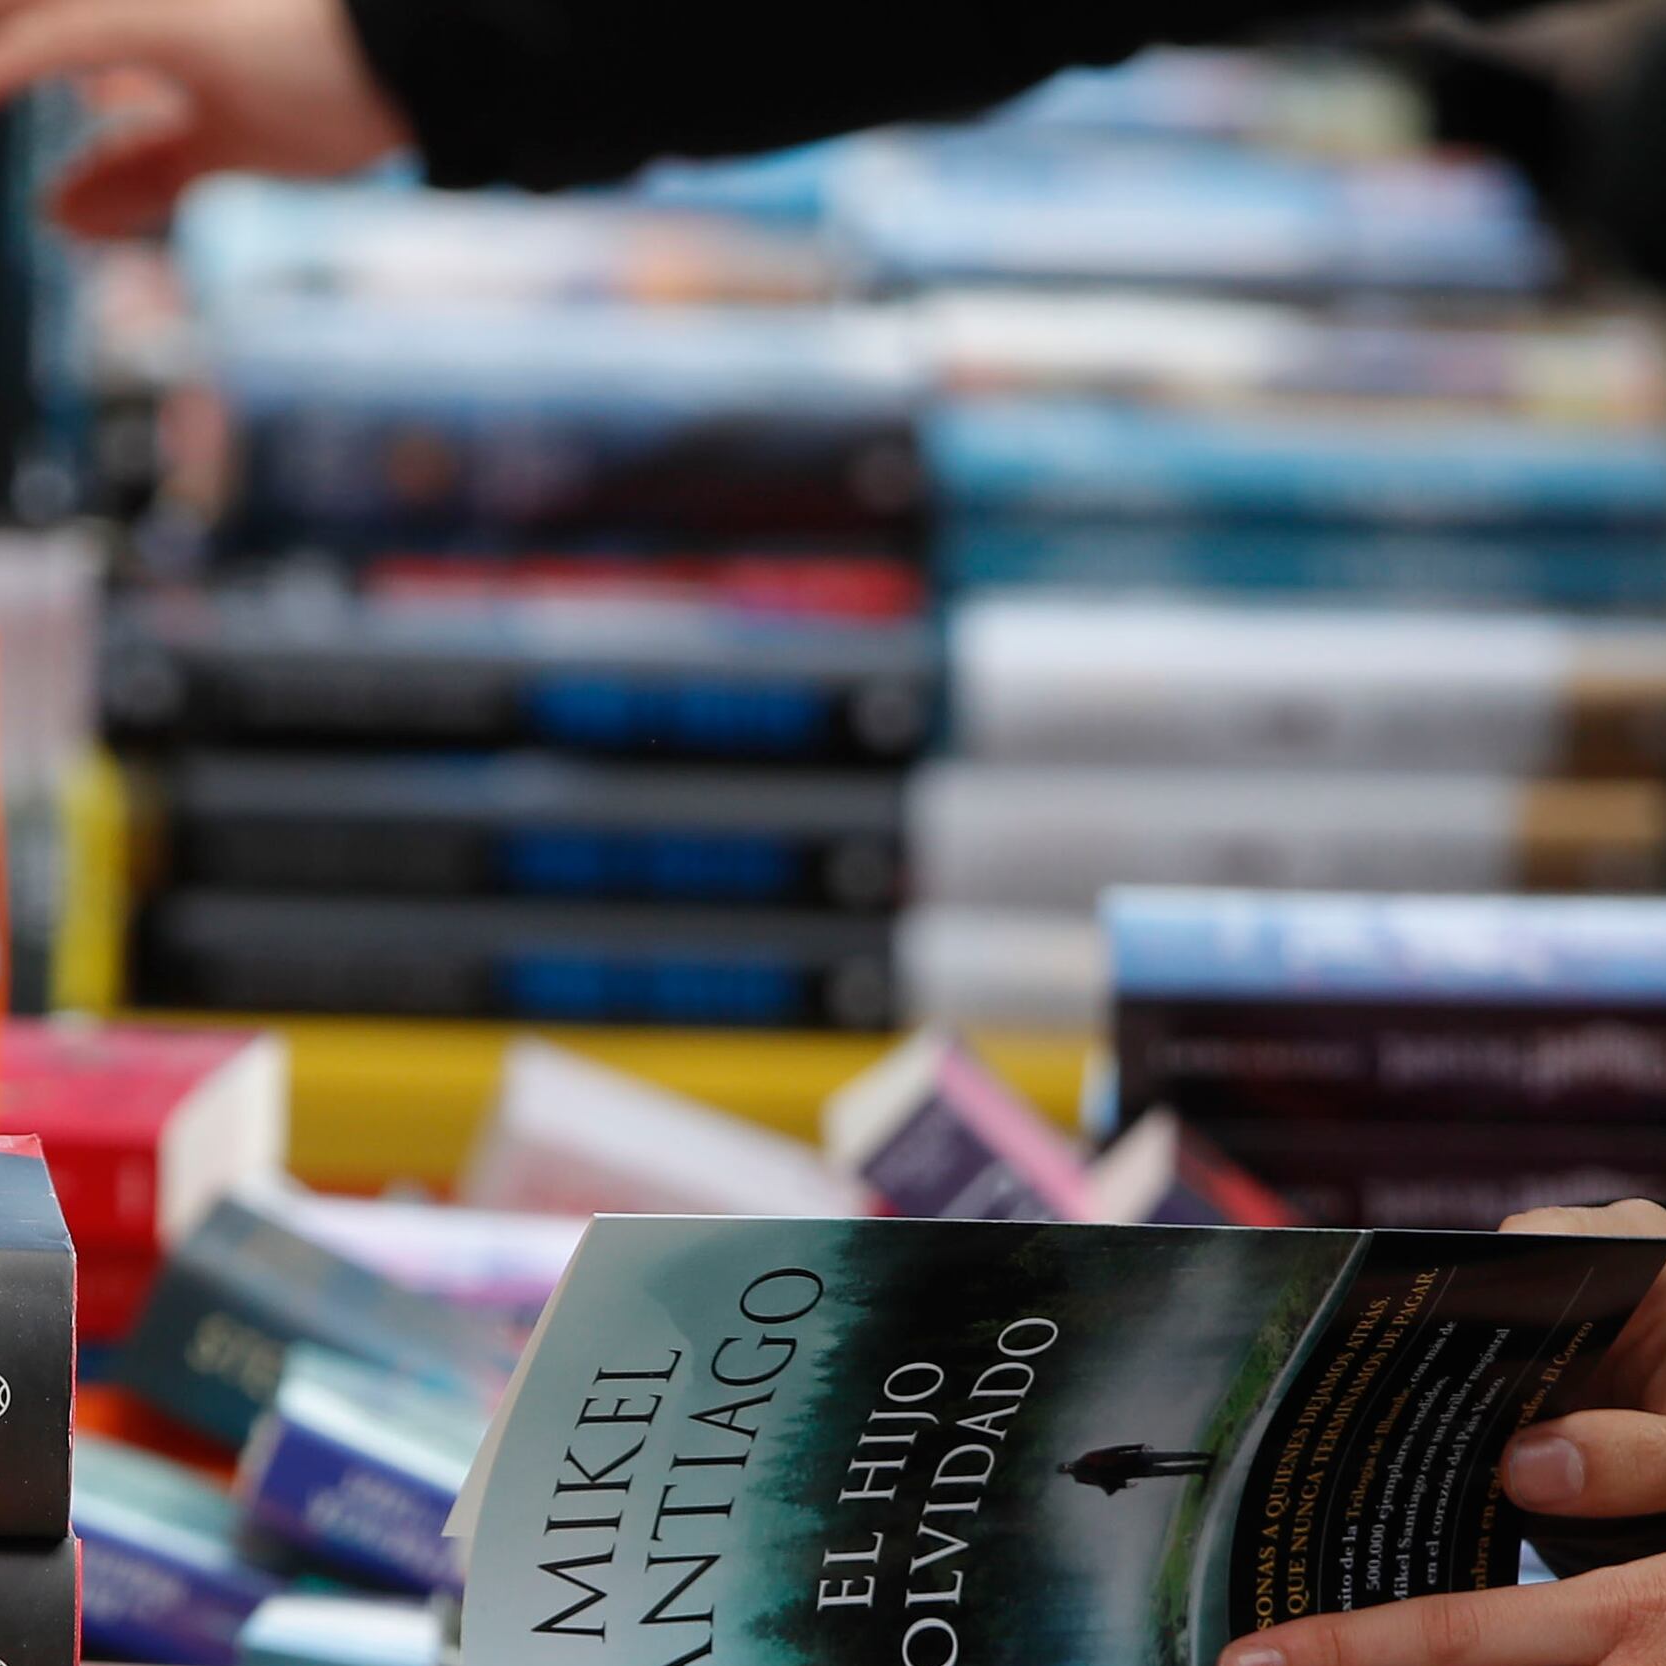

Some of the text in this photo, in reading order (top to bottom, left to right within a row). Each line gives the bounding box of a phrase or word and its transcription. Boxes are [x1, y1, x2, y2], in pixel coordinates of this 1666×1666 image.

[1376, 1327, 1404, 1349] DE
[1298, 1352, 1354, 1425] DEJAMOS
[1312, 1352, 1387, 1466] TERMINAMOS
[531, 1349, 682, 1643] MIKEL
[817, 1361, 945, 1611] EL HIJO
[1265, 1427, 1310, 1518] QUIENES
[1397, 1474, 1428, 1550] Santiago
[1420, 1445, 1437, 1472] con
[1433, 1469, 1457, 1535] corazón
[1262, 1524, 1280, 1539] A
[1291, 1470, 1324, 1551] NUNCA
[1342, 1525, 1358, 1542] la
[1366, 1524, 1386, 1591] 500.000
[1376, 1435, 1414, 1520] ejemplares
[1340, 1546, 1355, 1569] de
[1425, 1540, 1439, 1556] el
[1427, 1561, 1437, 1585] en
[1256, 1546, 1276, 1631] SONAS
[1287, 1557, 1309, 1614] QUE
